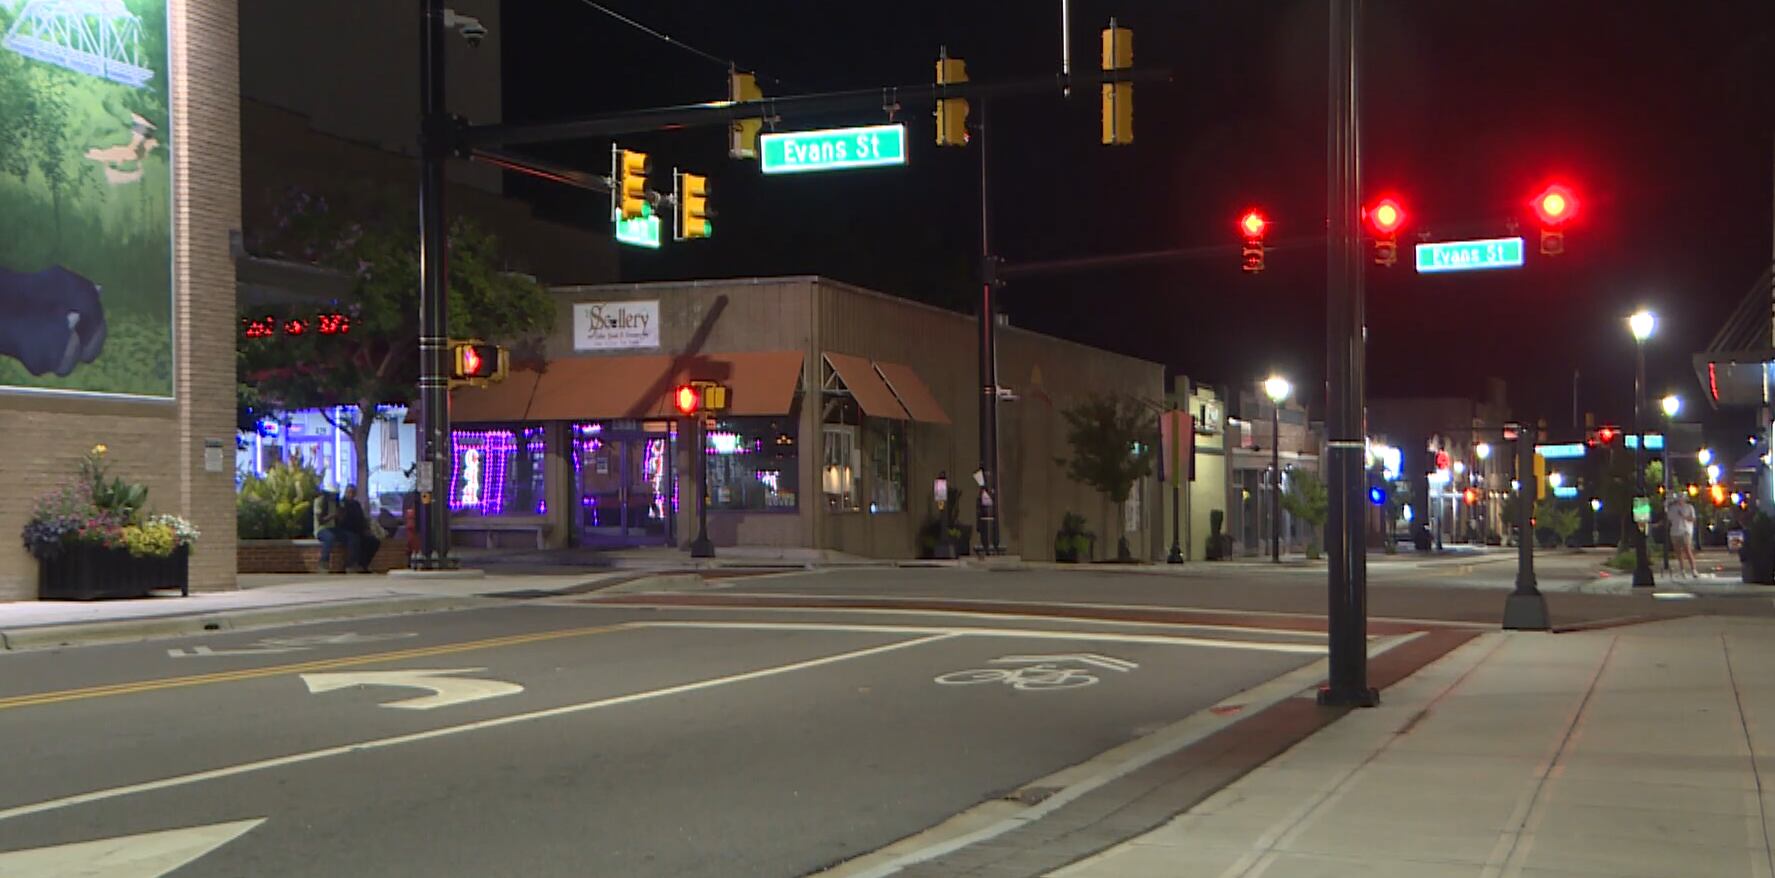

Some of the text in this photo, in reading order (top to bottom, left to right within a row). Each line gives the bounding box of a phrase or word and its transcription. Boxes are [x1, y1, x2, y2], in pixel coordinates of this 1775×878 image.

[783, 132, 880, 164] Evans St
[1433, 243, 1504, 264] Evans St
[587, 304, 650, 335] Scllery
